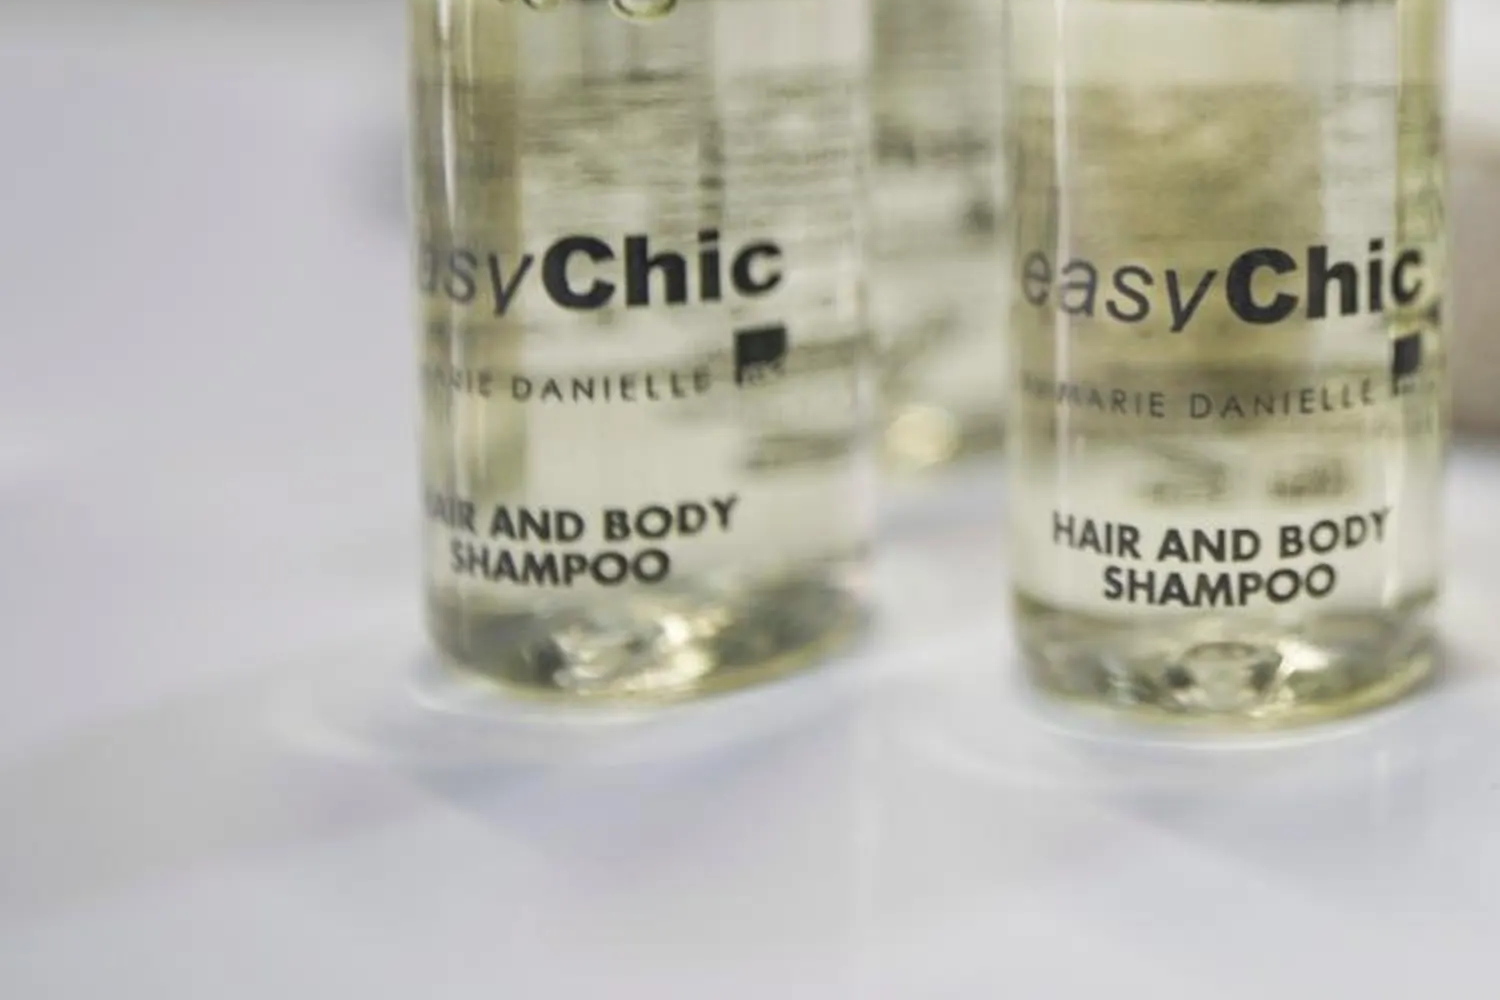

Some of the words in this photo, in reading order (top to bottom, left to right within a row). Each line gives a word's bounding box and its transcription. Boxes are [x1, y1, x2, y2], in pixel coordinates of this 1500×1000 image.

[421, 229, 783, 317] asyChic
[1021, 238, 1424, 333] easyChic
[511, 369, 713, 403] DANIELLE
[1190, 379, 1376, 420] DANIELLE
[428, 492, 476, 536] AIR
[490, 504, 585, 542] AND
[603, 494, 739, 541] BODY
[1053, 510, 1142, 559] HAIR
[1157, 527, 1261, 563] AND
[1279, 506, 1392, 559] BODY
[450, 537, 671, 587] SHAMPOO
[1103, 563, 1337, 608] SHAMPOO
